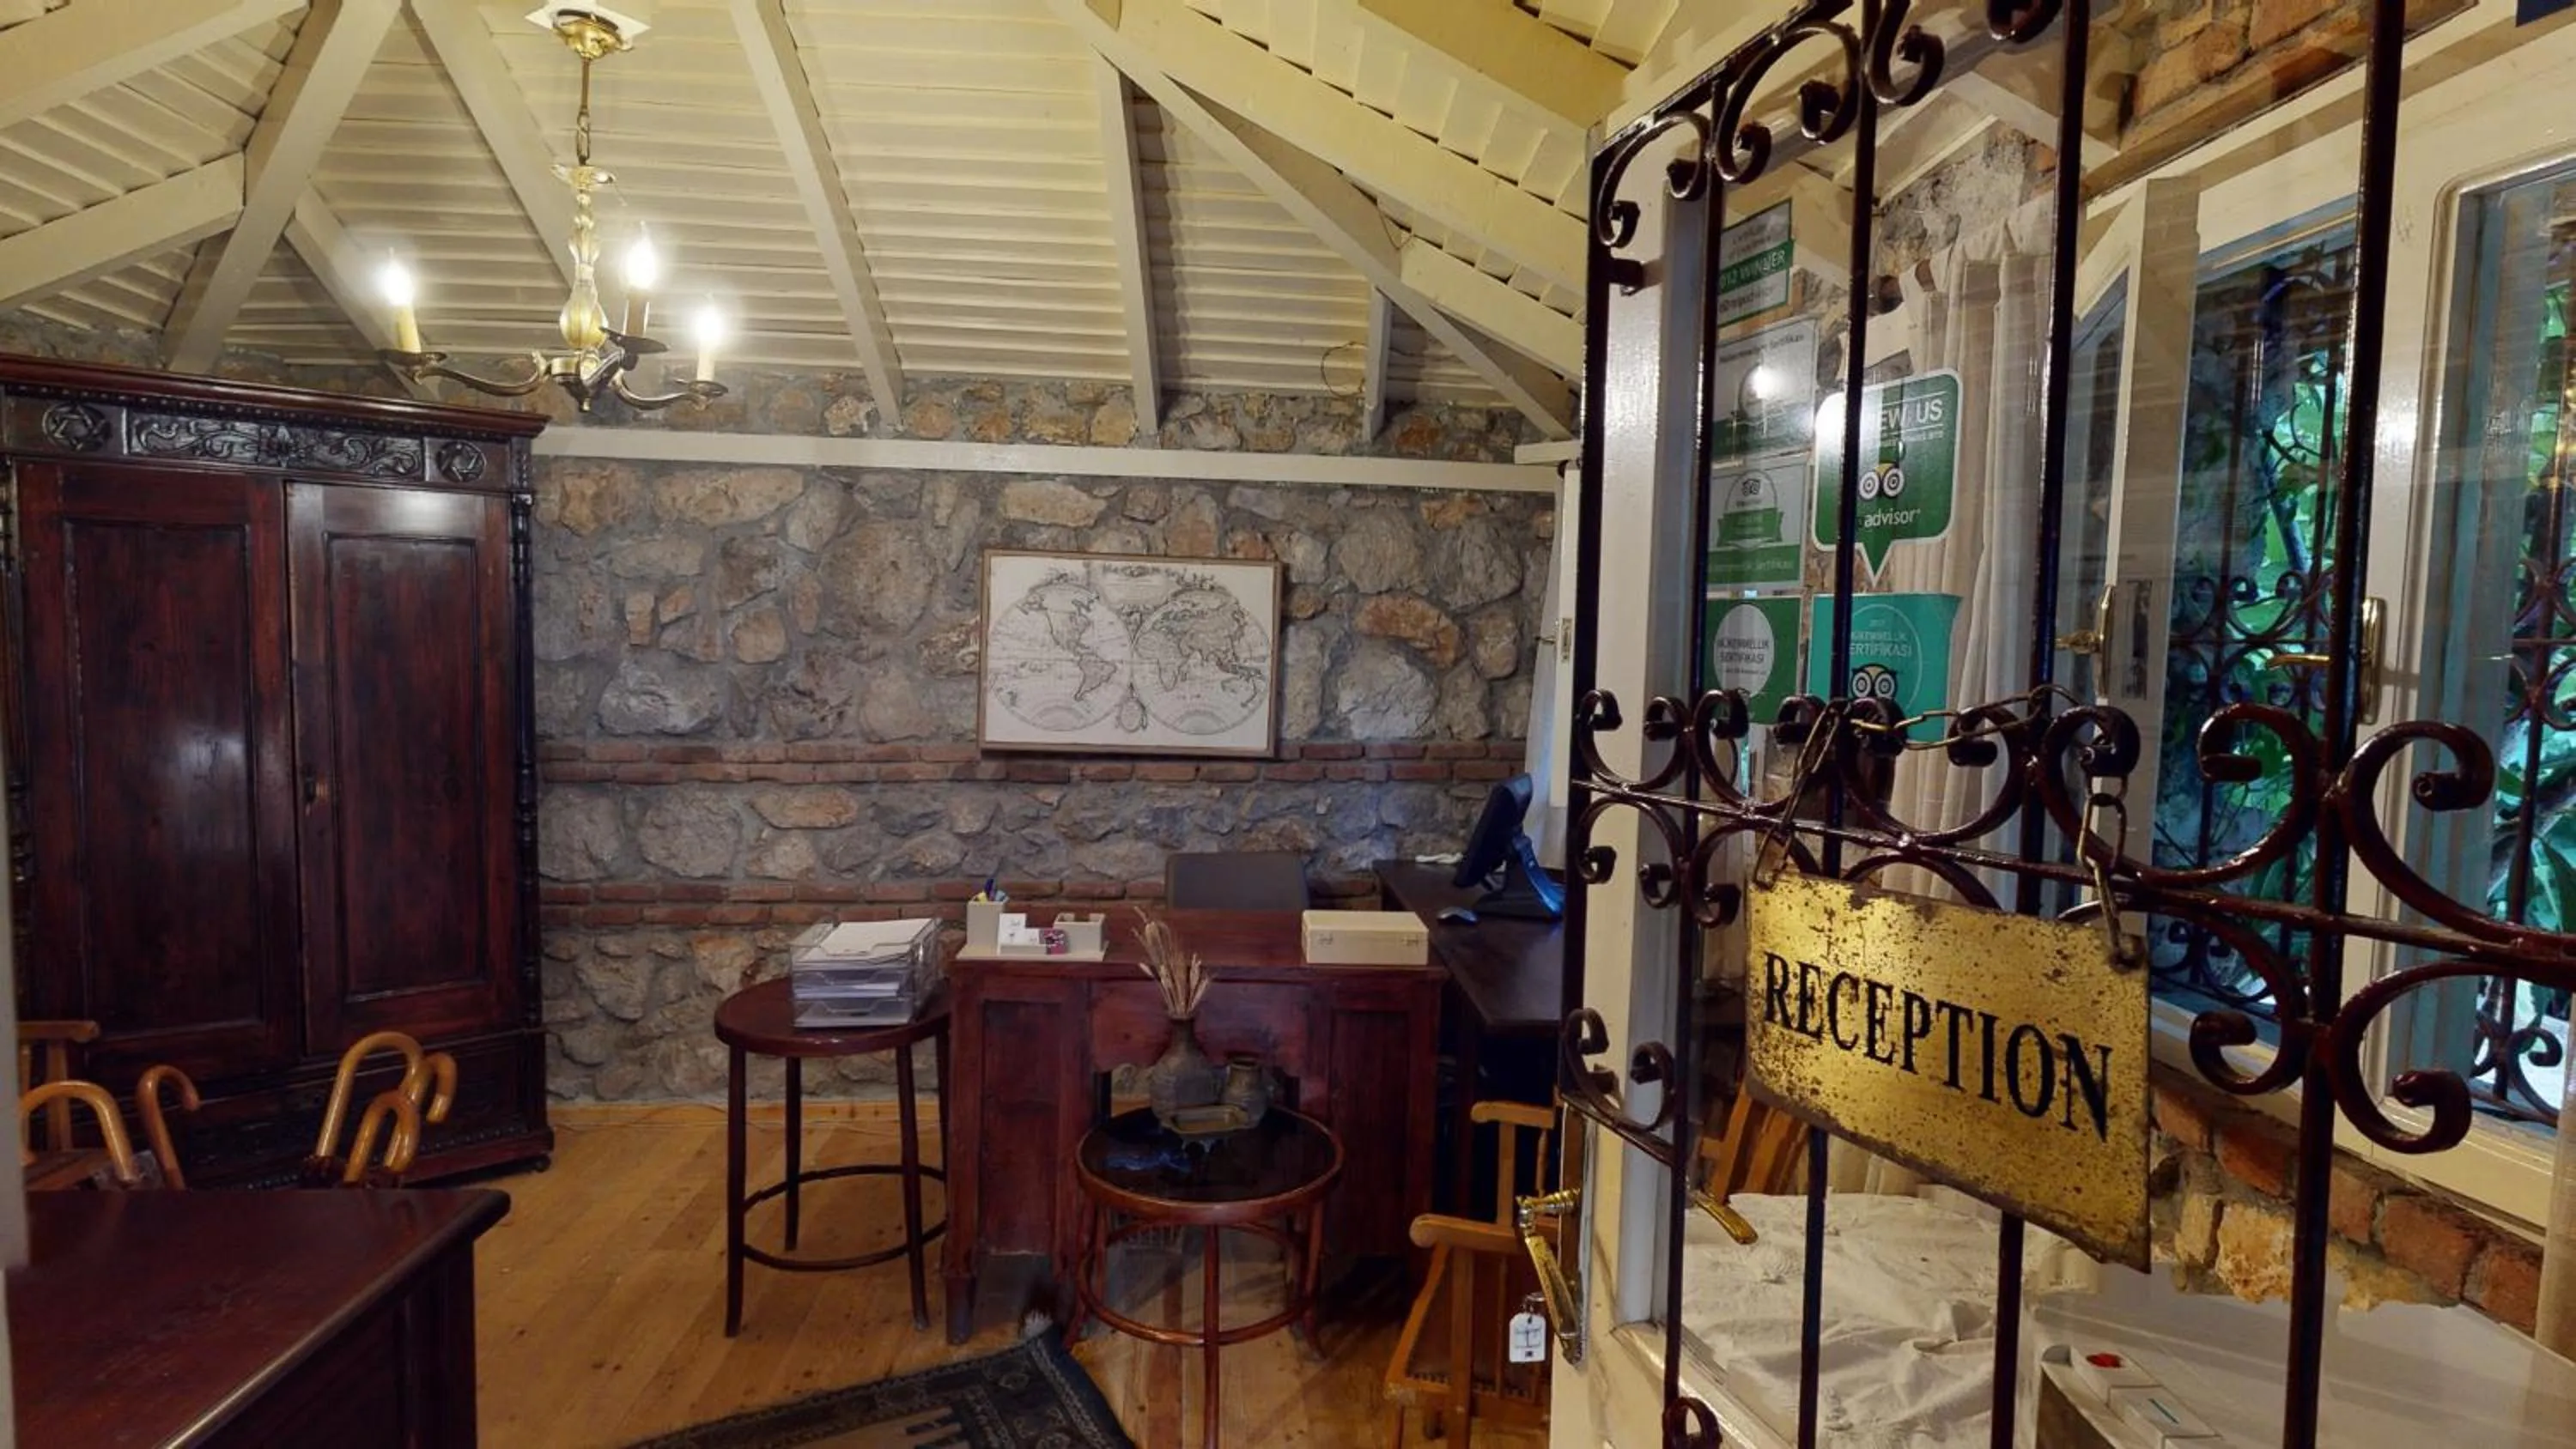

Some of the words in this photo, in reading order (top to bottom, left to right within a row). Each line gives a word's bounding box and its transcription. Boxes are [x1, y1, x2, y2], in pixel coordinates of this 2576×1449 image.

[1917, 398, 1943, 423] US
[1860, 508, 1917, 528] advisor
[1764, 951, 2112, 1143] RECEPTION
